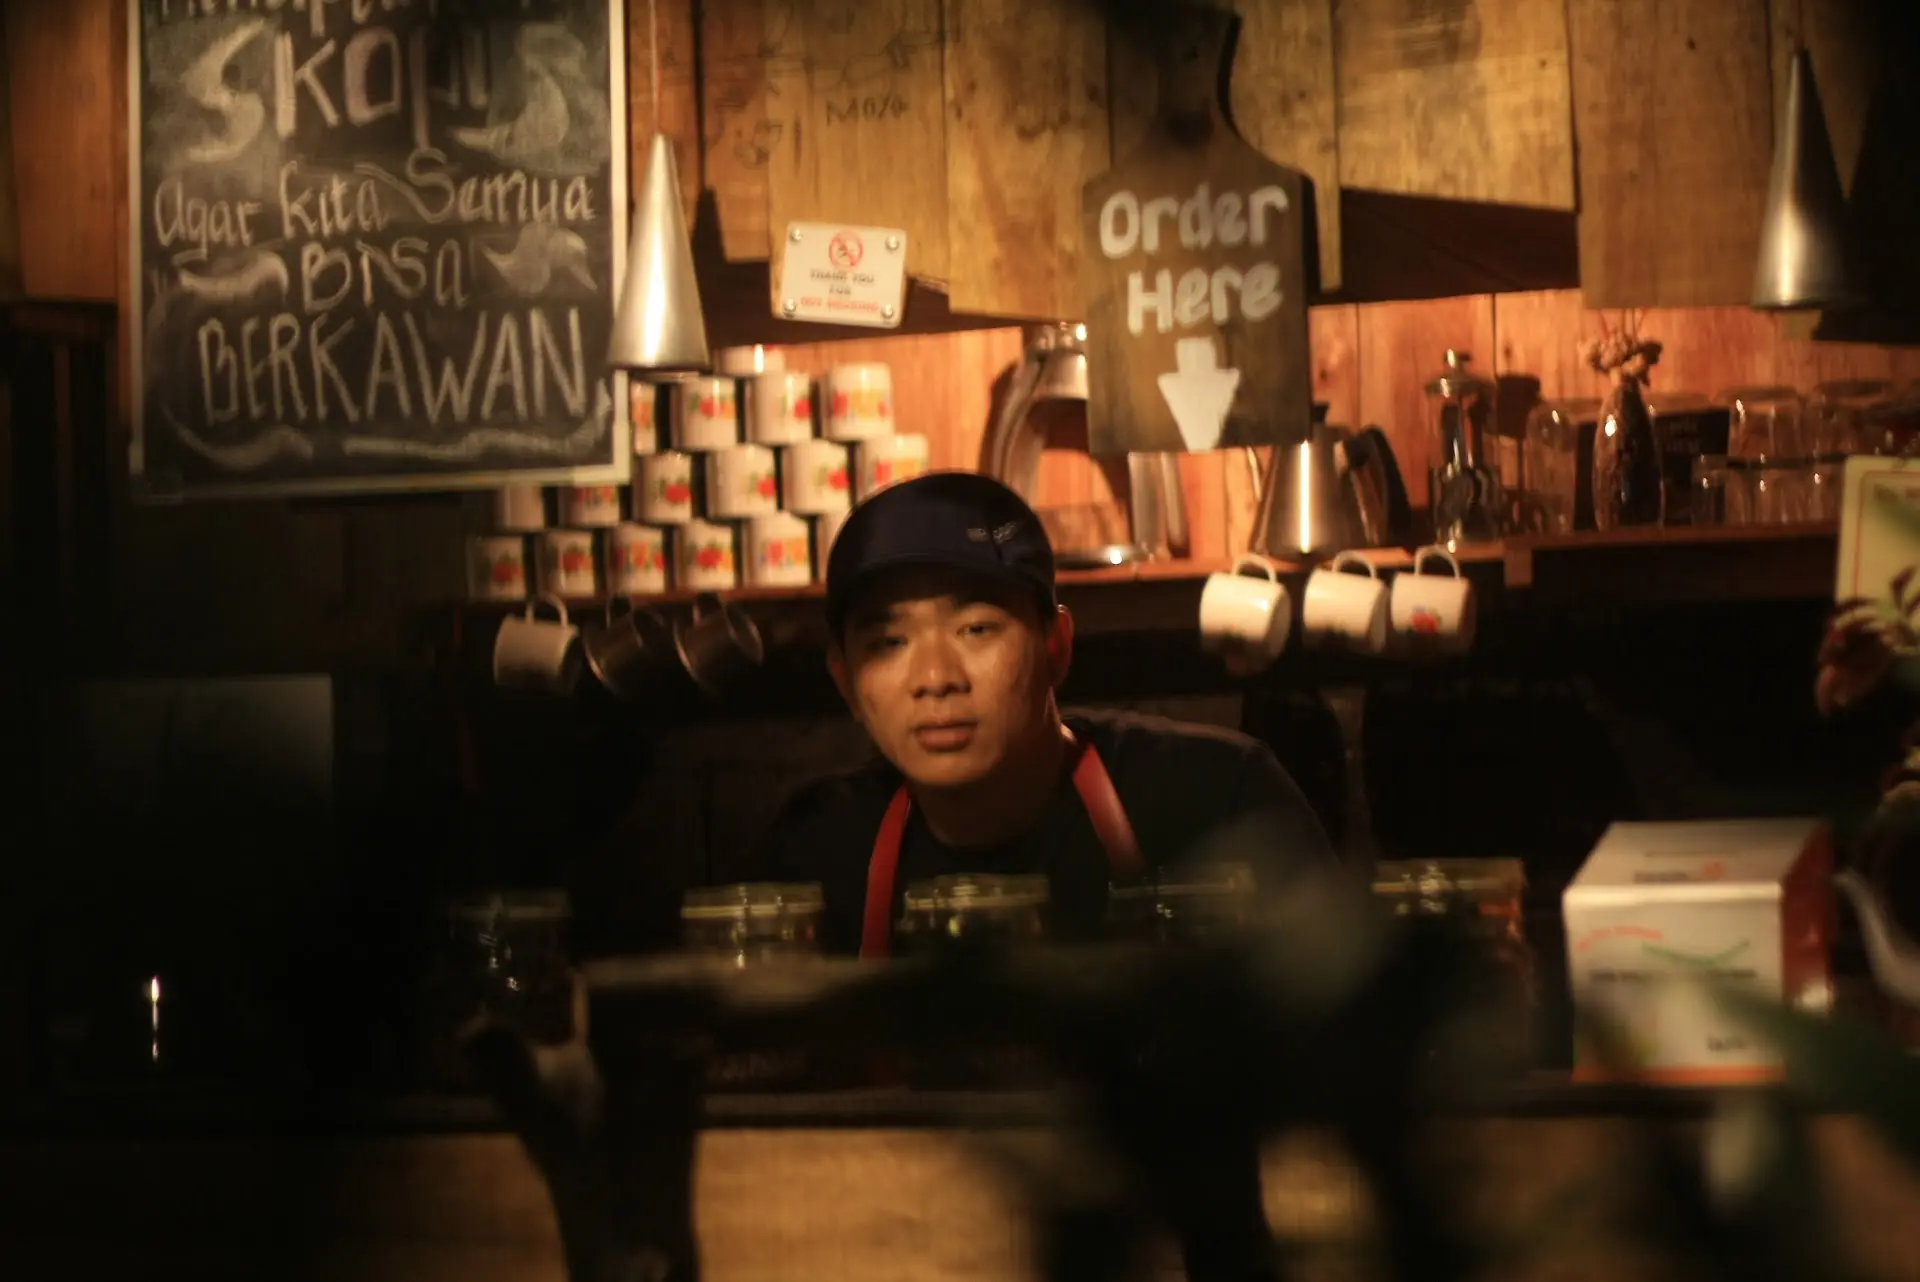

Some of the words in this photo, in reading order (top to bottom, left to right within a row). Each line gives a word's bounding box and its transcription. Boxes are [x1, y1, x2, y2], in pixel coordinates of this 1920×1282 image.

[1100, 181, 1289, 260] Order
[1127, 261, 1284, 336] Here
[198, 306, 586, 425] BERKAWAN
